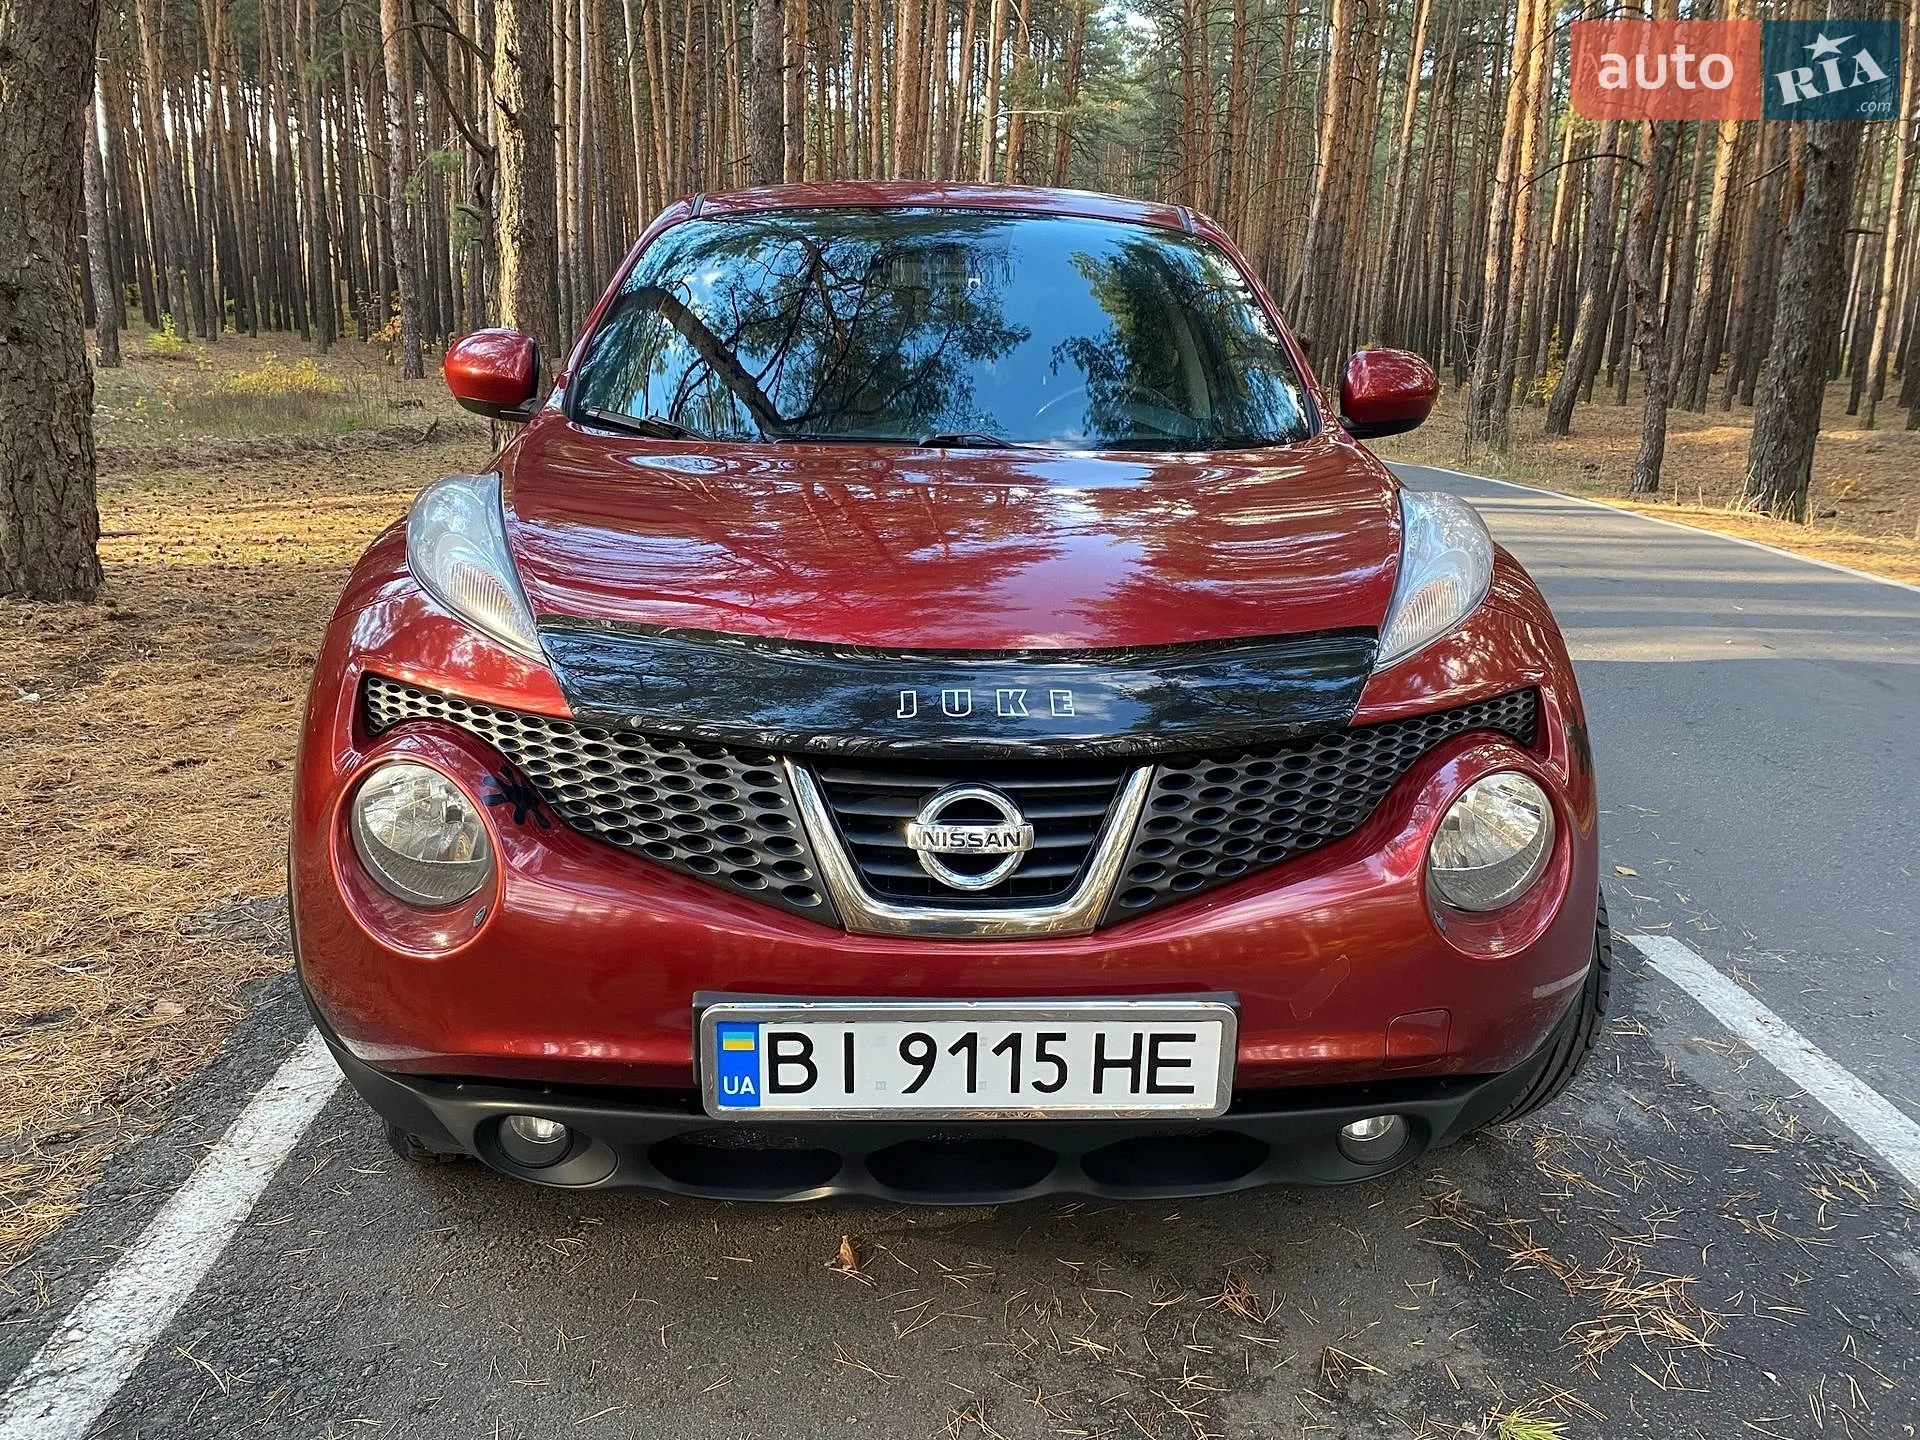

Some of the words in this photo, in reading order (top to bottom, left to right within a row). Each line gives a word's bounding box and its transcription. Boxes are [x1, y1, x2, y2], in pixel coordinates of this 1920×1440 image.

[896, 688, 1075, 718] JUKE
[921, 830, 1021, 848] NISSAN
[767, 1031, 855, 1095] BI
[898, 1031, 1069, 1095] 9115
[1092, 1032, 1197, 1095] HE
[722, 1075, 756, 1096] UA
